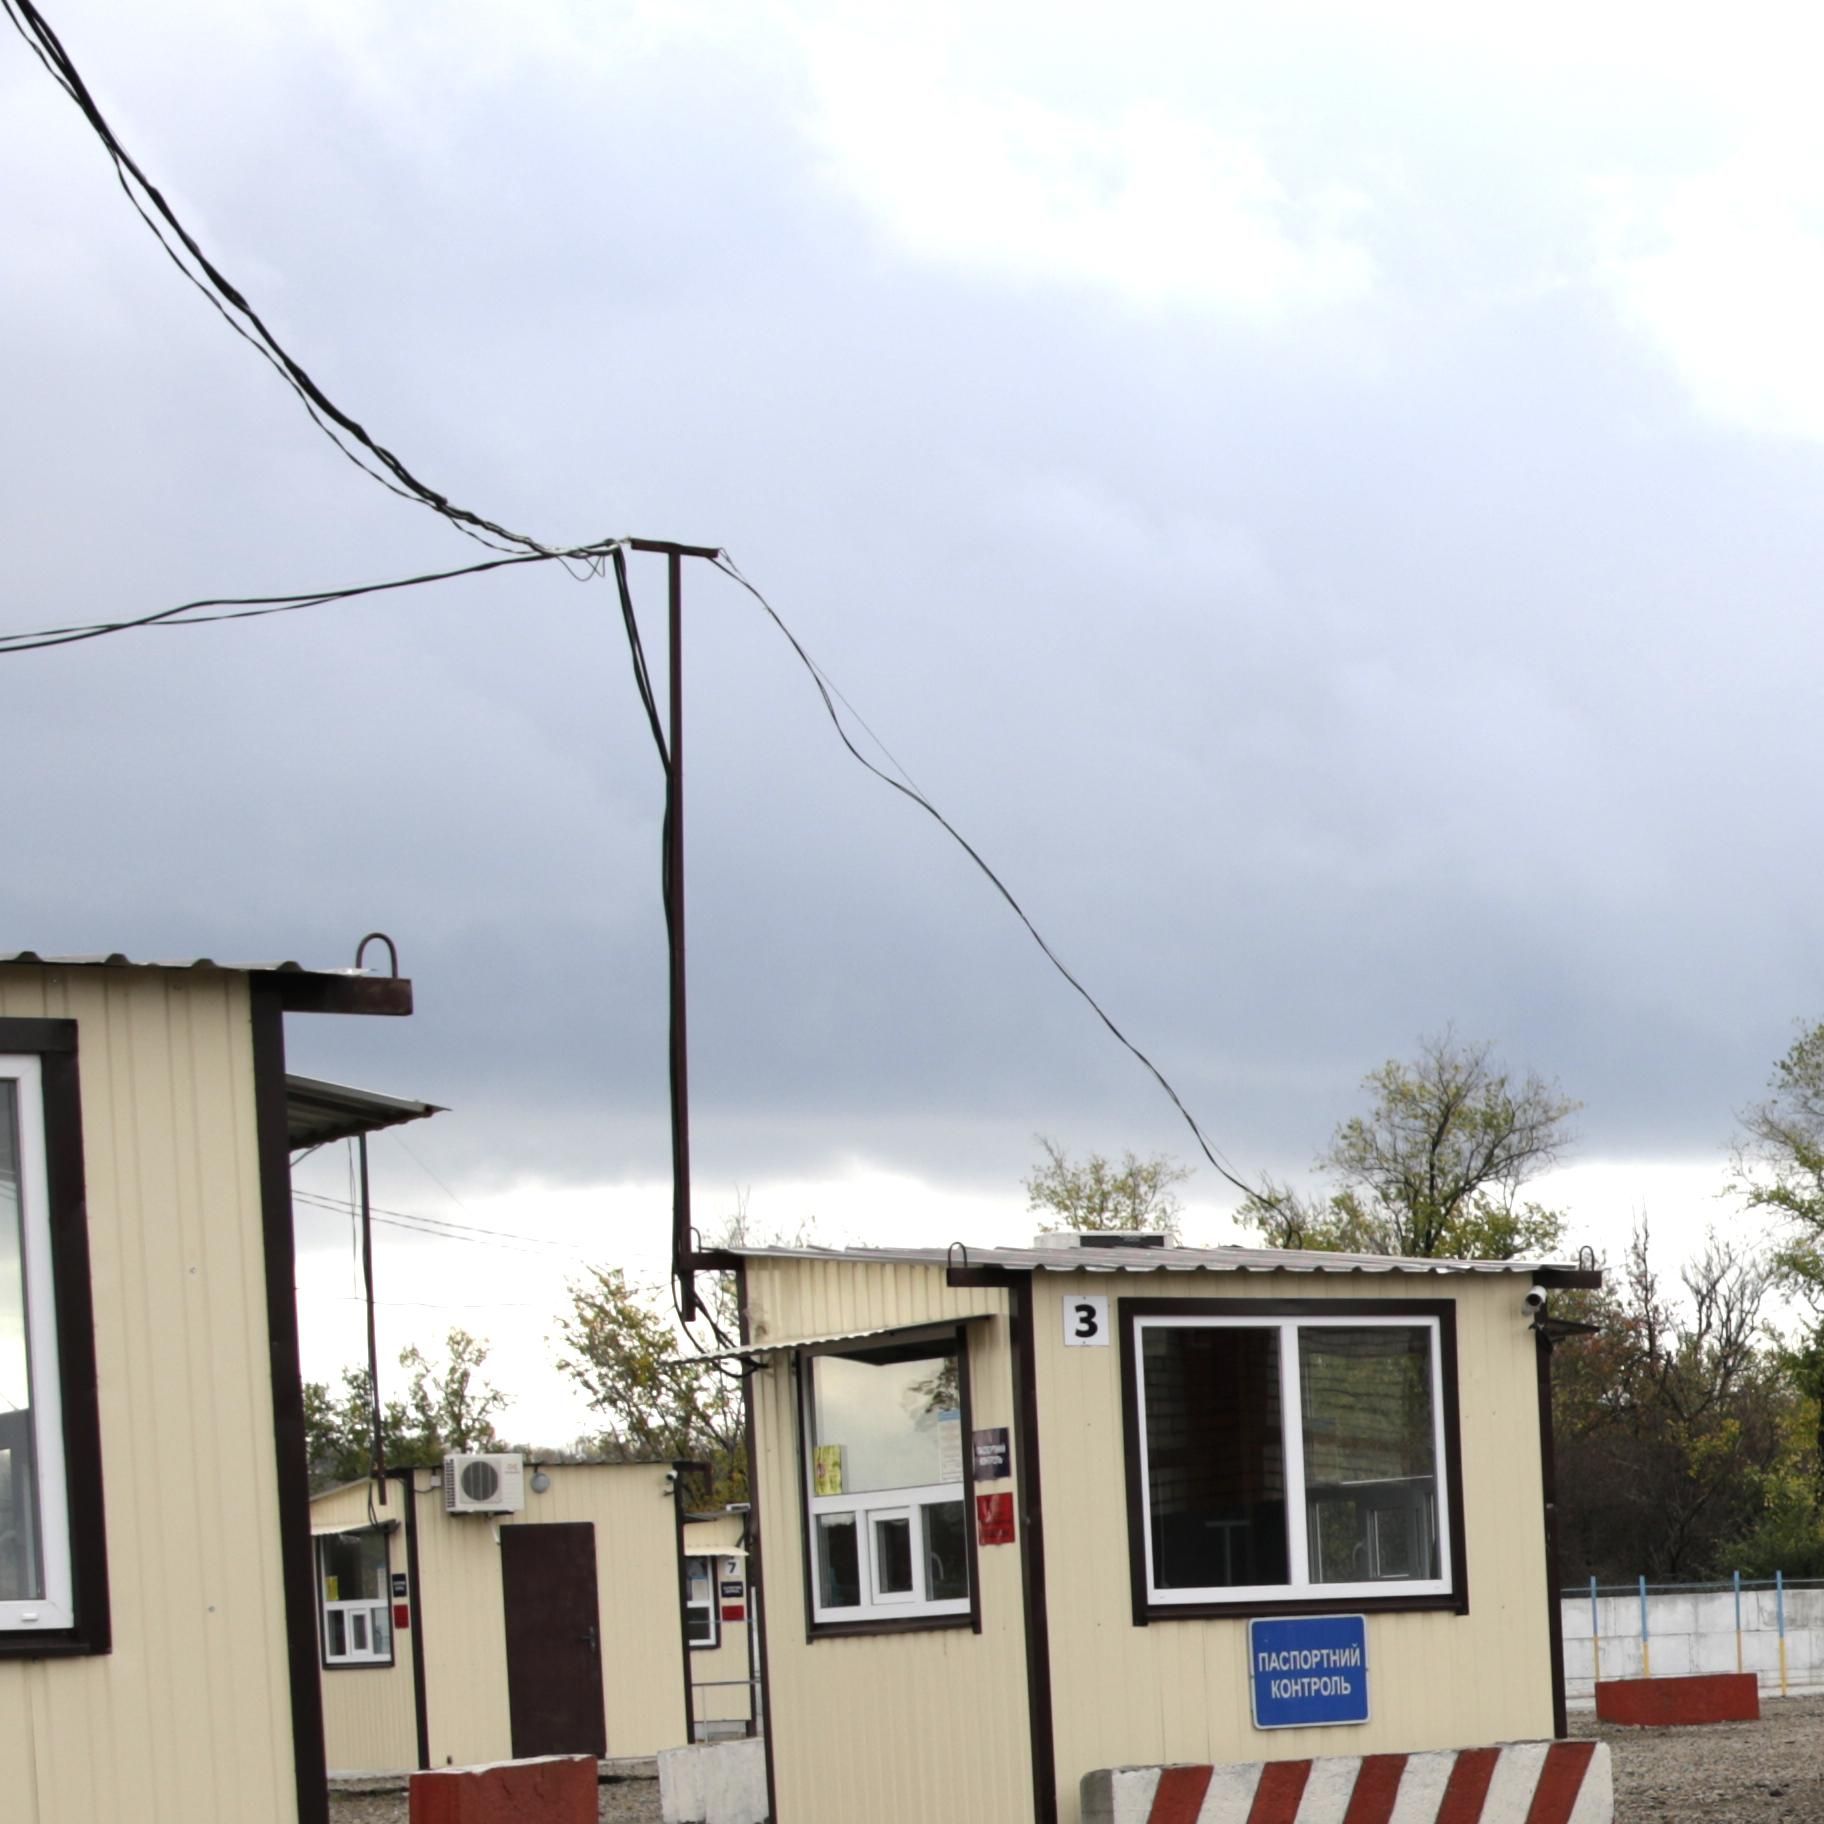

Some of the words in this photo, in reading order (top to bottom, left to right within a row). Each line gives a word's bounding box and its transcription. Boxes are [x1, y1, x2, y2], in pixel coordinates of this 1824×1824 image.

[1075, 1304, 1098, 1338] 3
[727, 1561, 737, 1574] 7
[1258, 1643, 1361, 1672] ПАСПОРТНИЙ
[1271, 1676, 1352, 1699] КОНТРОЛЬ
